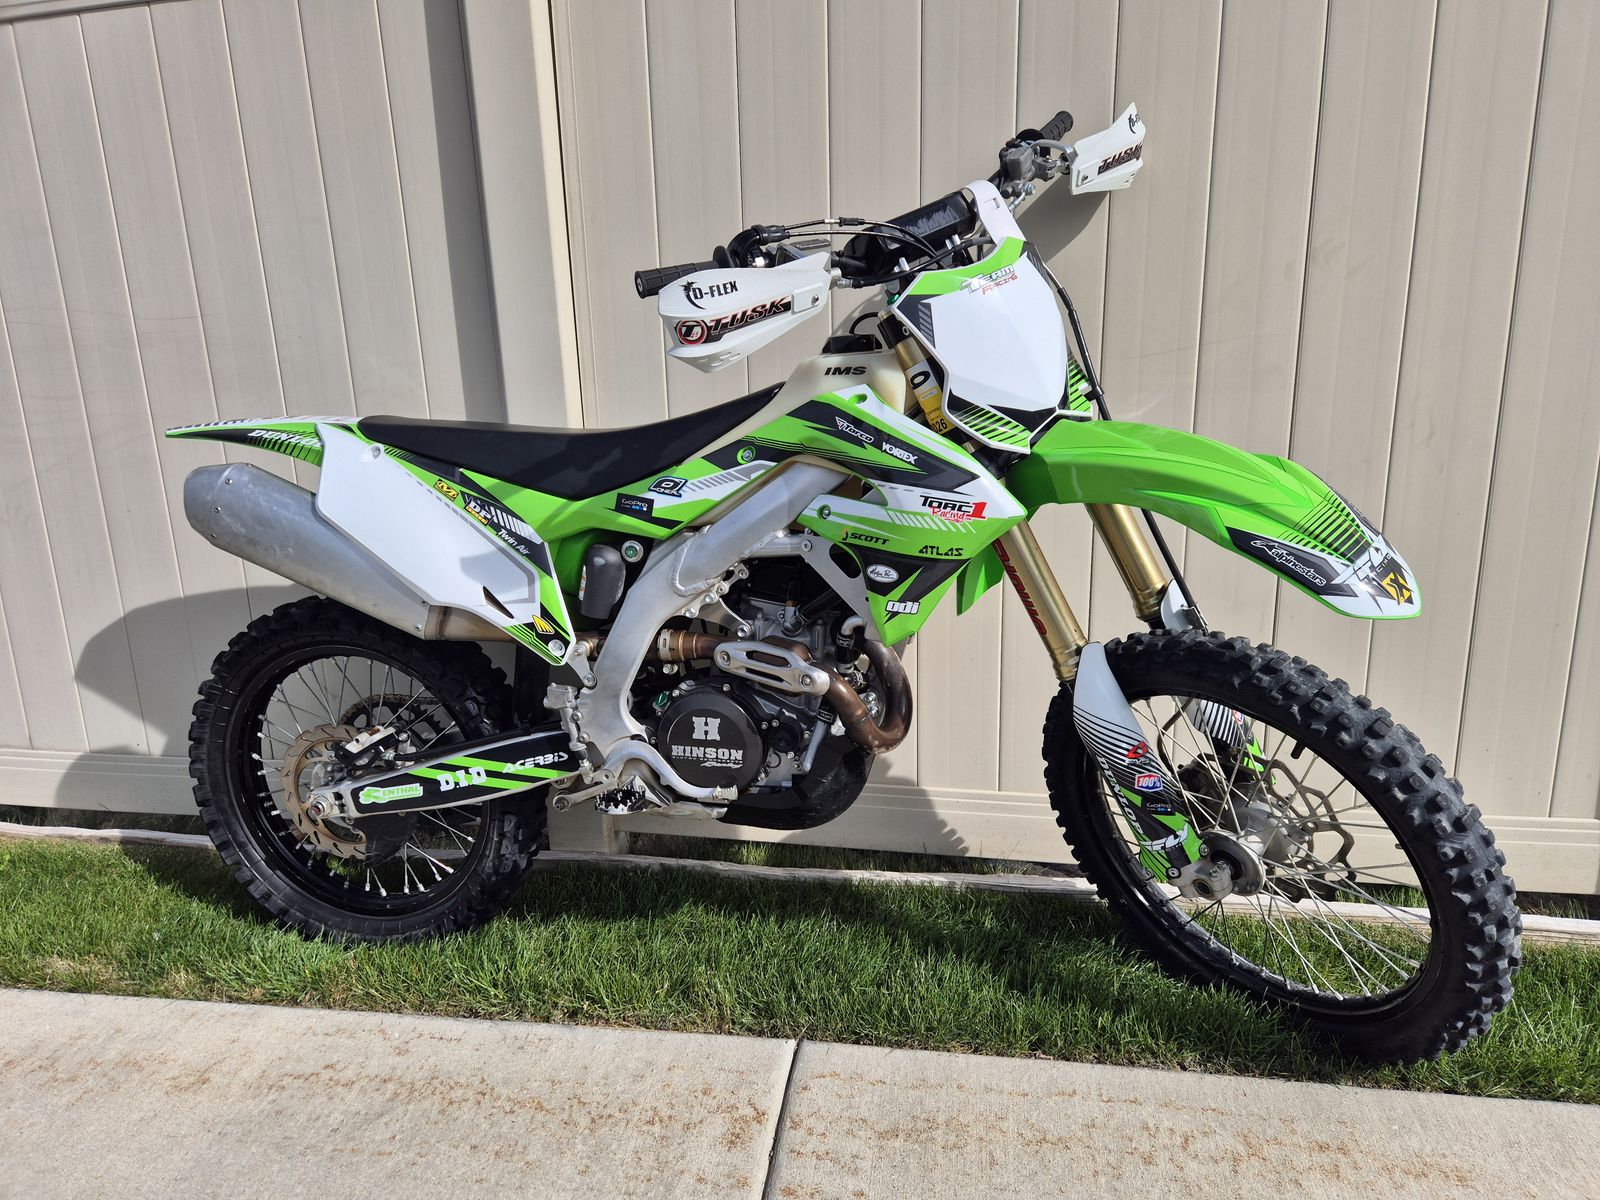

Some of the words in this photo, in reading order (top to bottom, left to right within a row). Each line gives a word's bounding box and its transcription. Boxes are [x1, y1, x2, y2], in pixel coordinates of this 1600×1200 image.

[692, 280, 738, 300] D-FLEX
[709, 296, 790, 334] TUSK
[824, 366, 867, 376] IMS
[882, 441, 918, 465] VORTEX
[849, 531, 890, 546] SCOTT
[918, 544, 964, 557] ATLAS
[692, 716, 721, 741] H
[671, 744, 744, 761] HINSON
[1138, 776, 1161, 788] 100%
[1096, 754, 1145, 836] DUNLOP
